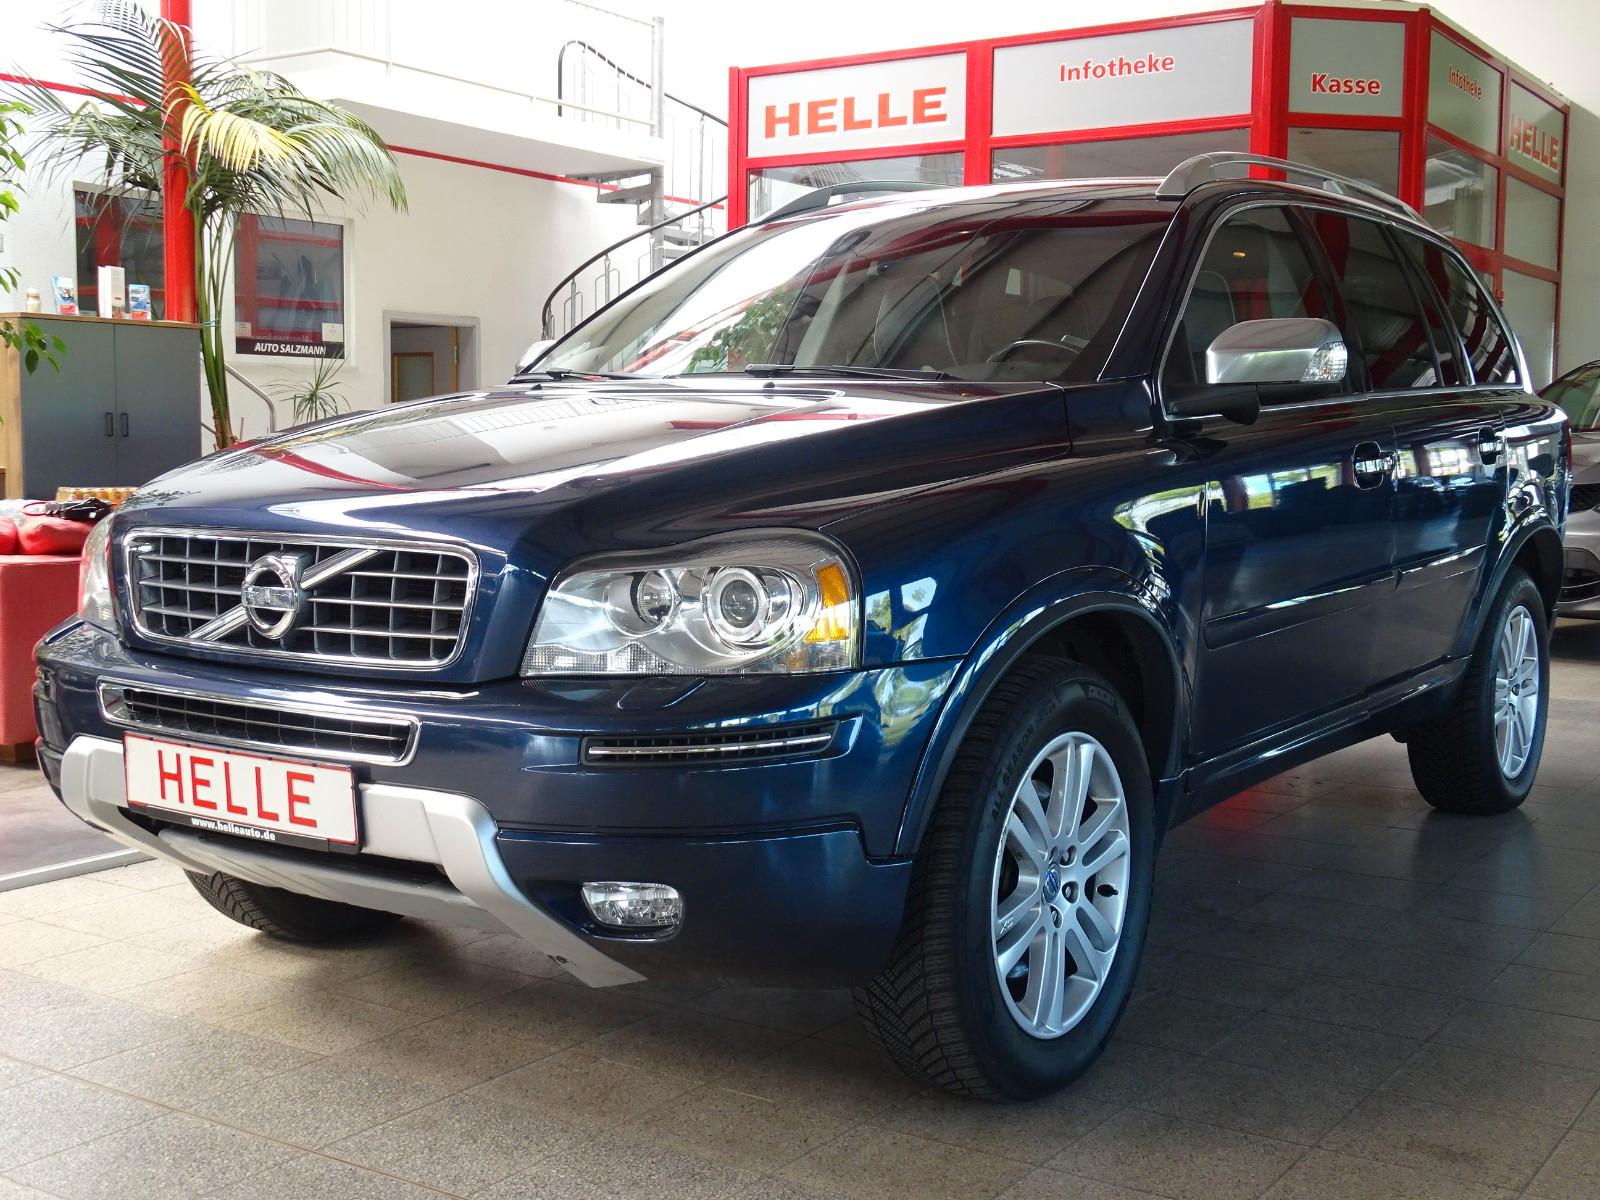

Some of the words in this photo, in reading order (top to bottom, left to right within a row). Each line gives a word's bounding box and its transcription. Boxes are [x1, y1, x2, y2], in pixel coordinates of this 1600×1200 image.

[1059, 54, 1175, 83] Infotheke
[1311, 73, 1381, 96] Kasse
[1448, 65, 1482, 100] Infotheke
[764, 86, 947, 138] HELLE
[1510, 113, 1559, 170] HELLE
[254, 342, 279, 353] AUTO
[280, 343, 326, 355] SALZMANN
[157, 750, 318, 828] HELLE
[191, 816, 276, 842] www.helleauto.de
